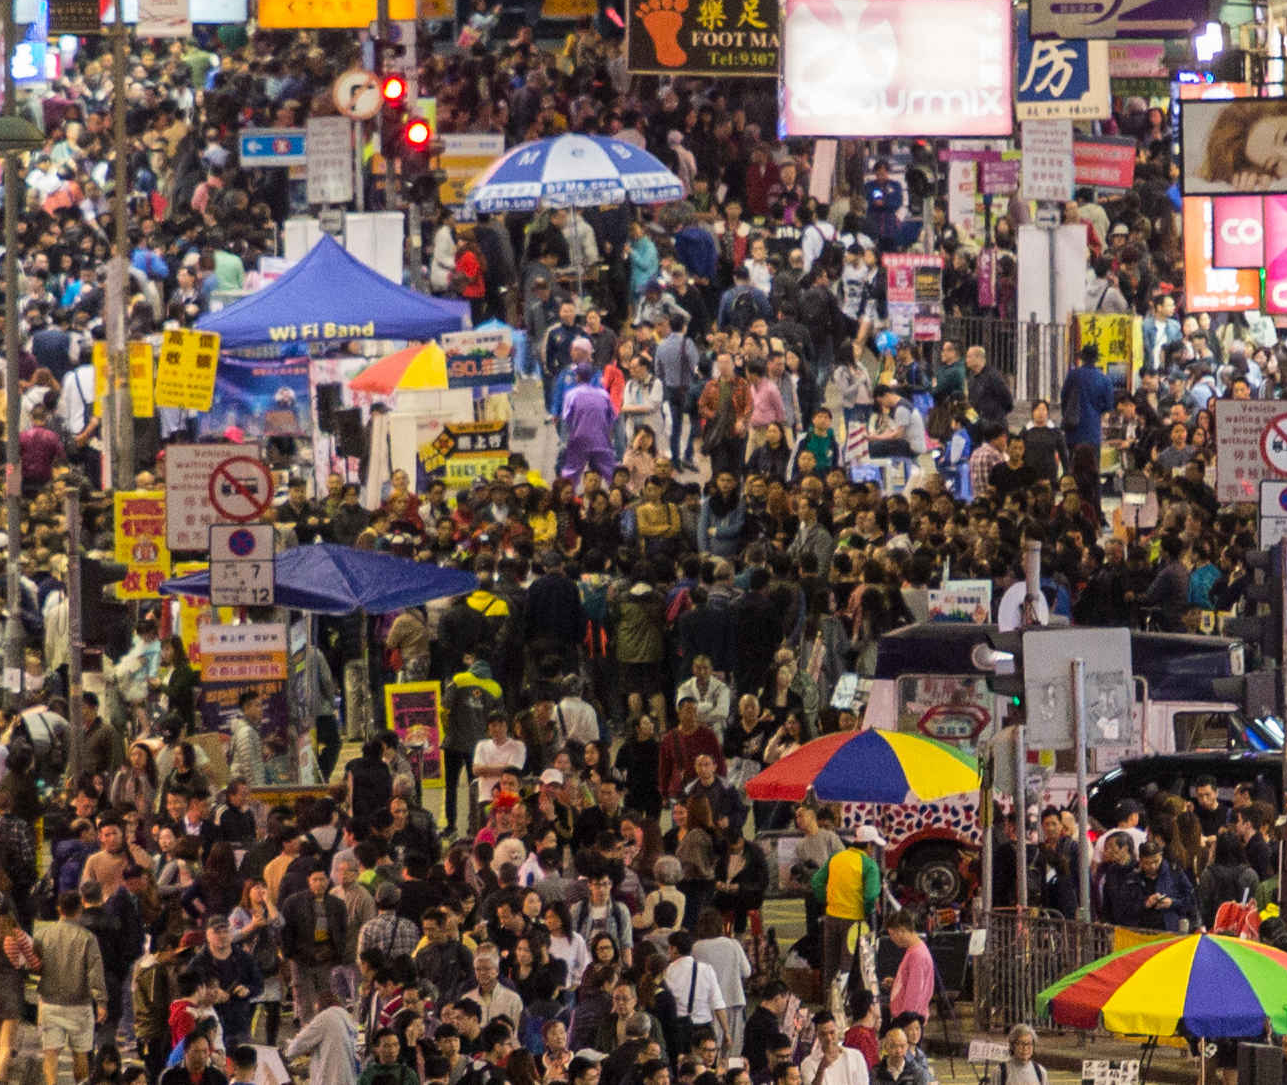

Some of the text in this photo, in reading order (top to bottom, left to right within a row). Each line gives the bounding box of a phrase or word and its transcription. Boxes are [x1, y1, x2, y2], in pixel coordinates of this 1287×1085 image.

[691, 31, 746, 47] FOOT
[269, 324, 297, 341] Wi
[323, 321, 374, 339] Band
[251, 564, 261, 579] 7
[251, 588, 270, 603] 12
